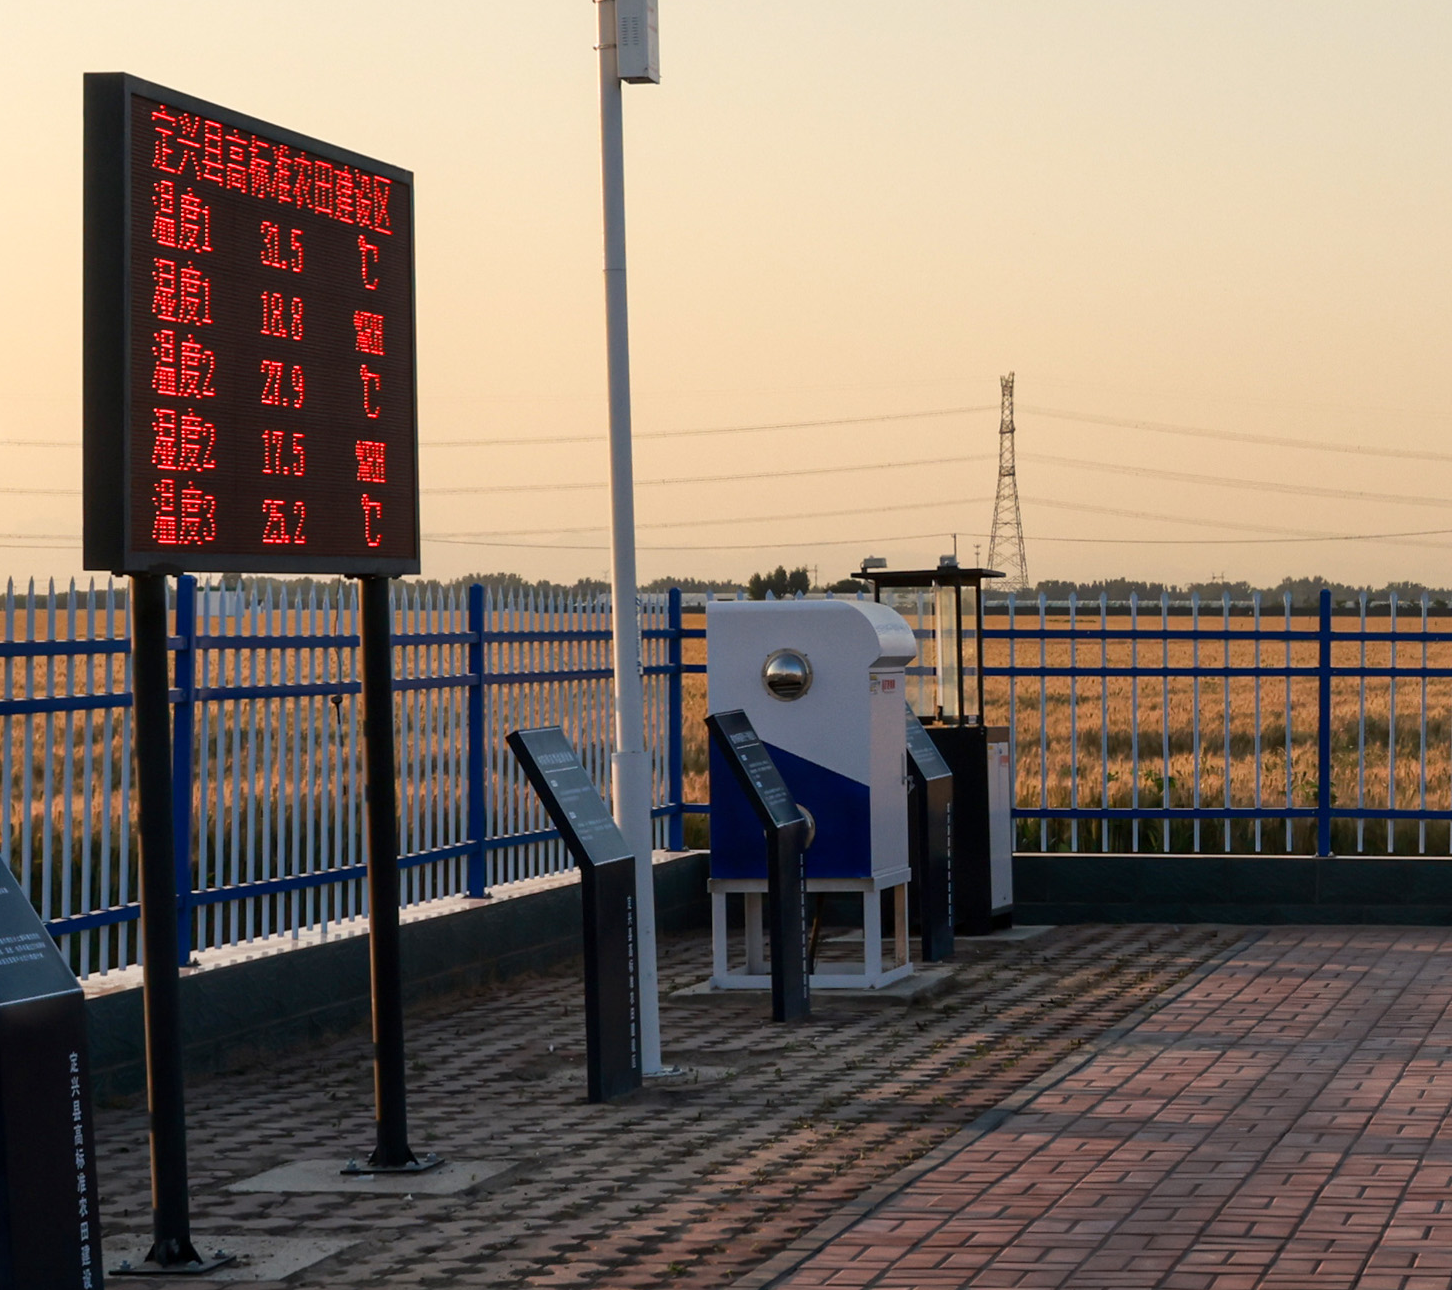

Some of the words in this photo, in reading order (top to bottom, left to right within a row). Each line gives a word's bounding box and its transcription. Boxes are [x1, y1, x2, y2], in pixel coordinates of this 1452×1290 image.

[150, 104, 395, 235] 定兴县高标准农田建设区
[150, 177, 215, 254] 温度1
[260, 220, 305, 274] 31.5
[150, 256, 215, 326] 湿度1
[259, 290, 305, 342] 18.8
[150, 329, 217, 399] 温度2
[259, 359, 305, 410] 27.9
[150, 407, 217, 473] 湿度2
[260, 429, 306, 478] 17.5
[150, 479, 217, 546] 温度3
[261, 498, 308, 546] 25.2
